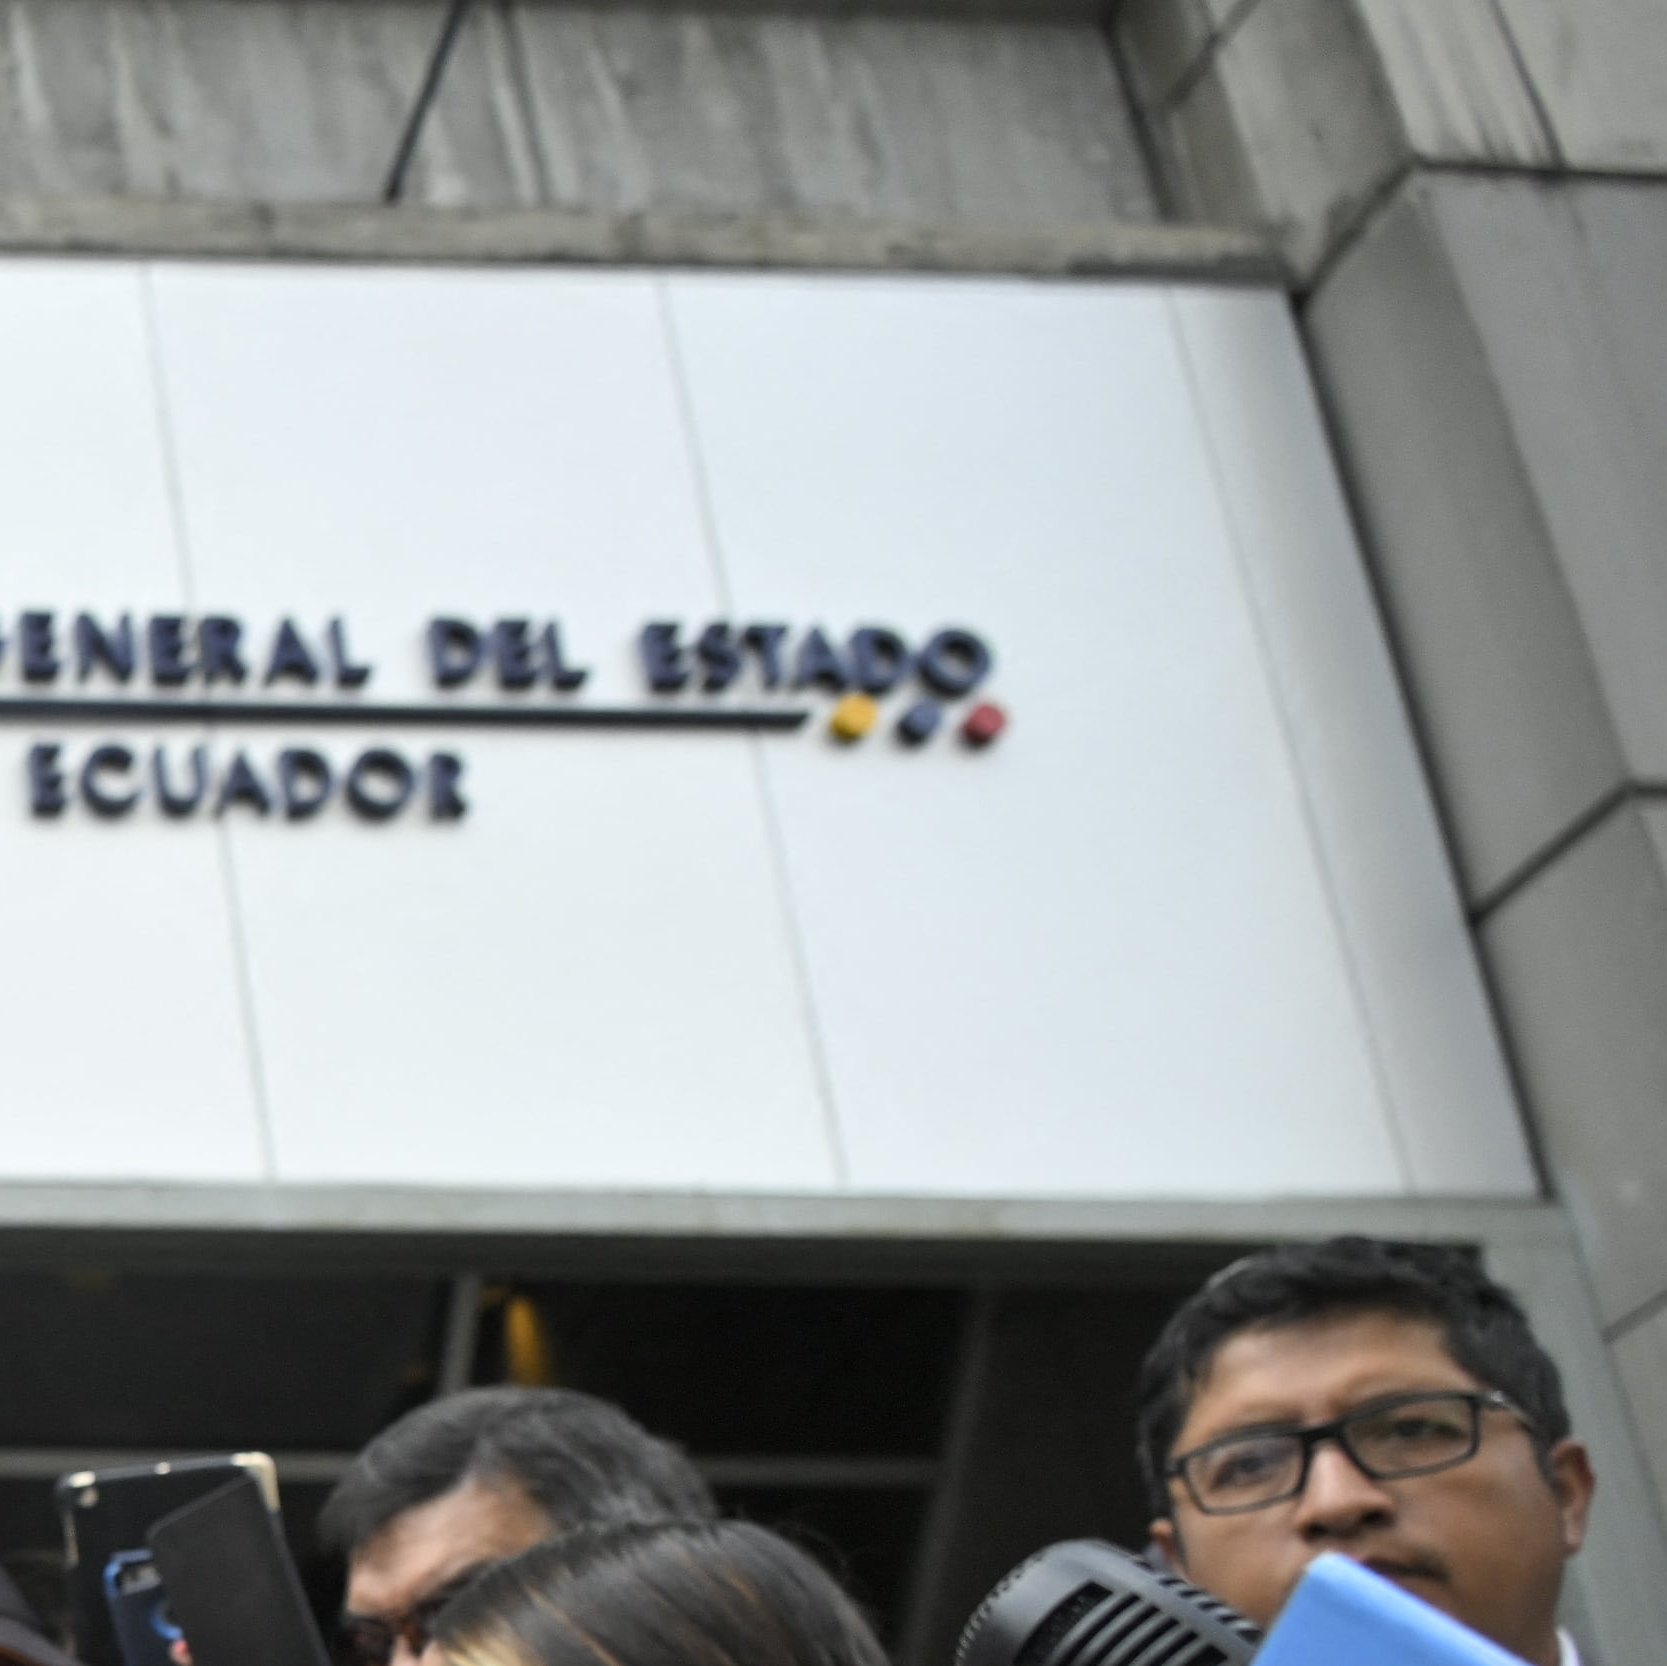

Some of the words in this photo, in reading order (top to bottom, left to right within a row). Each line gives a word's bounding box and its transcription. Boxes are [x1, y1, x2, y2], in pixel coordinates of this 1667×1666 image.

[427, 617, 589, 698] DEL
[639, 621, 993, 699] ESTADO
[27, 743, 470, 826] ECUADOR
